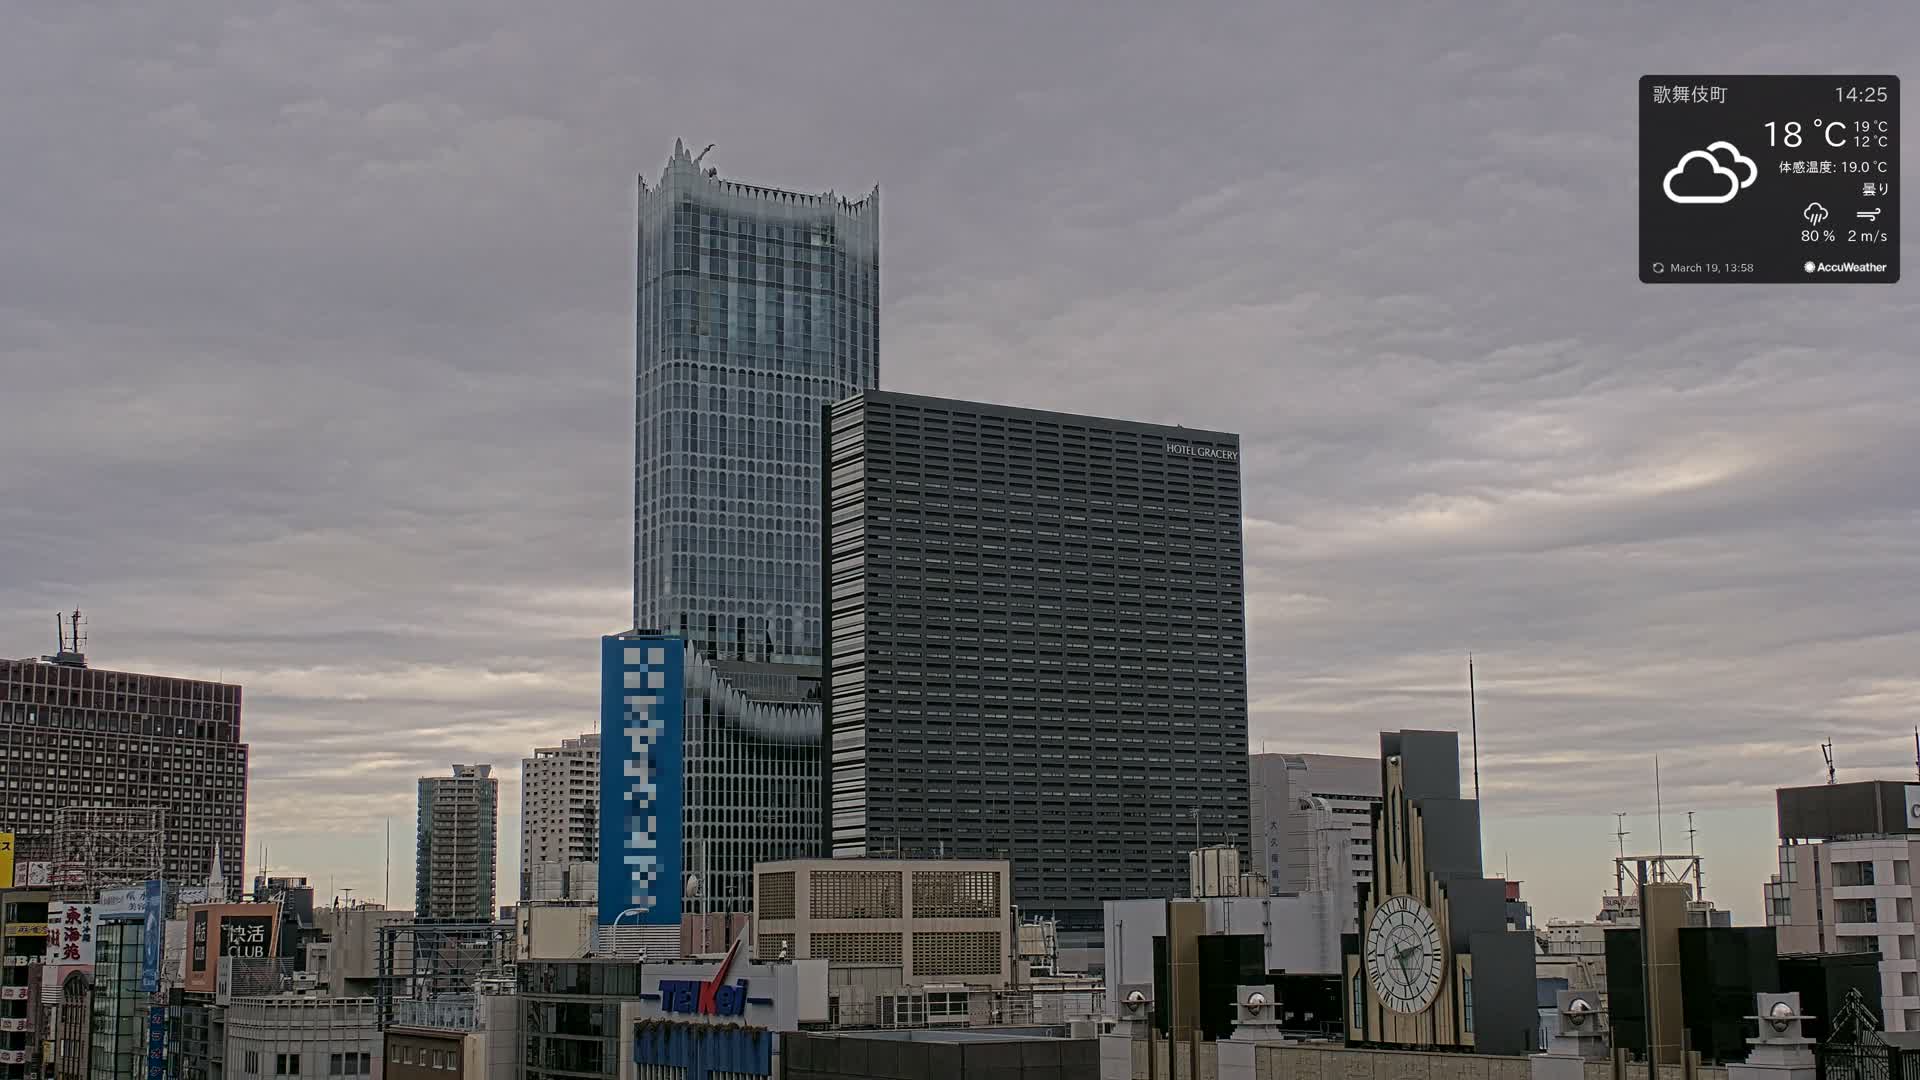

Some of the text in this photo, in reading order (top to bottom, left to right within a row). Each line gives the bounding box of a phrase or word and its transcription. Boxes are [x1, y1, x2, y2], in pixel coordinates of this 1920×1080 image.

[1166, 443, 1238, 460] HOTEL GRACERY
[61, 905, 82, 960] 東海苑
[229, 924, 265, 943] 快活
[228, 945, 264, 958] CLUB
